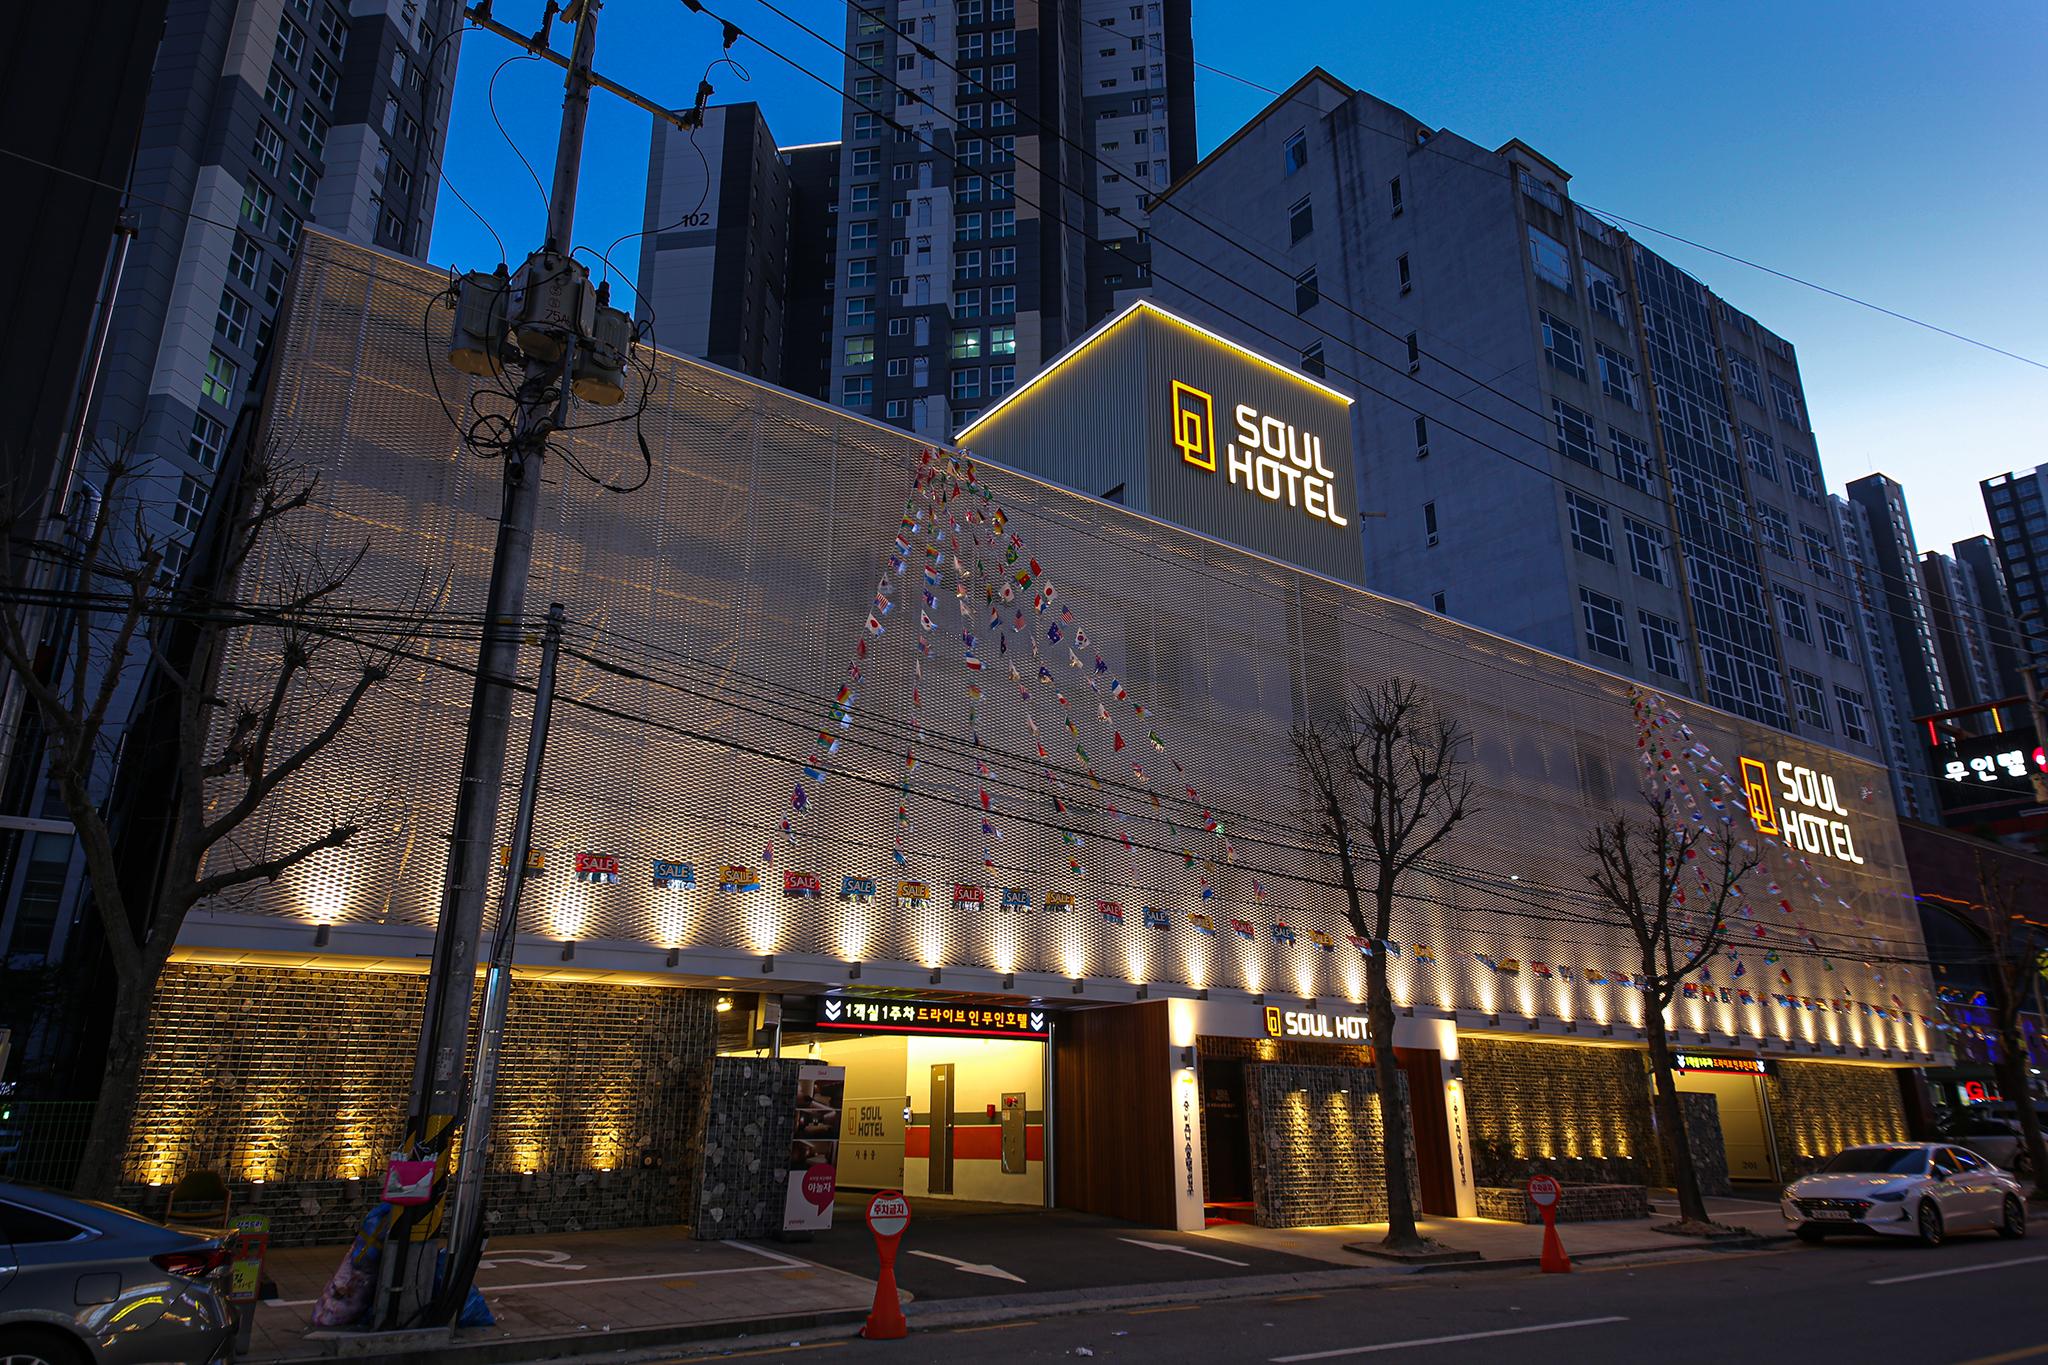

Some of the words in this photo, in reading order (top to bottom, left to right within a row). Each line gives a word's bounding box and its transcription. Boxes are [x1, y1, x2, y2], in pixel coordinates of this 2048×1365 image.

[682, 212, 710, 227] 102
[1236, 403, 1335, 479] SOUL
[1228, 443, 1348, 526] HOTEL
[1944, 749, 2028, 782] 무인텔
[1776, 760, 1848, 816] SOUL
[1779, 806, 1864, 865] HOTEL
[582, 857, 613, 870] SALE
[659, 864, 689, 878] SALE
[725, 871, 753, 884] SALE
[790, 876, 816, 888] SALE
[847, 881, 872, 892] SALE
[902, 885, 925, 897] SALE
[958, 889, 980, 900] SALE
[1006, 892, 1027, 903] SALE
[845, 1002, 879, 1022] 1객실
[882, 1004, 916, 1022] 1주차
[1285, 1011, 1334, 1038] SOUL
[1335, 1015, 1374, 1040] HOT
[860, 1106, 882, 1121] SOUL
[858, 1123, 885, 1137] HOTEL
[874, 1203, 904, 1215] 주차금지
